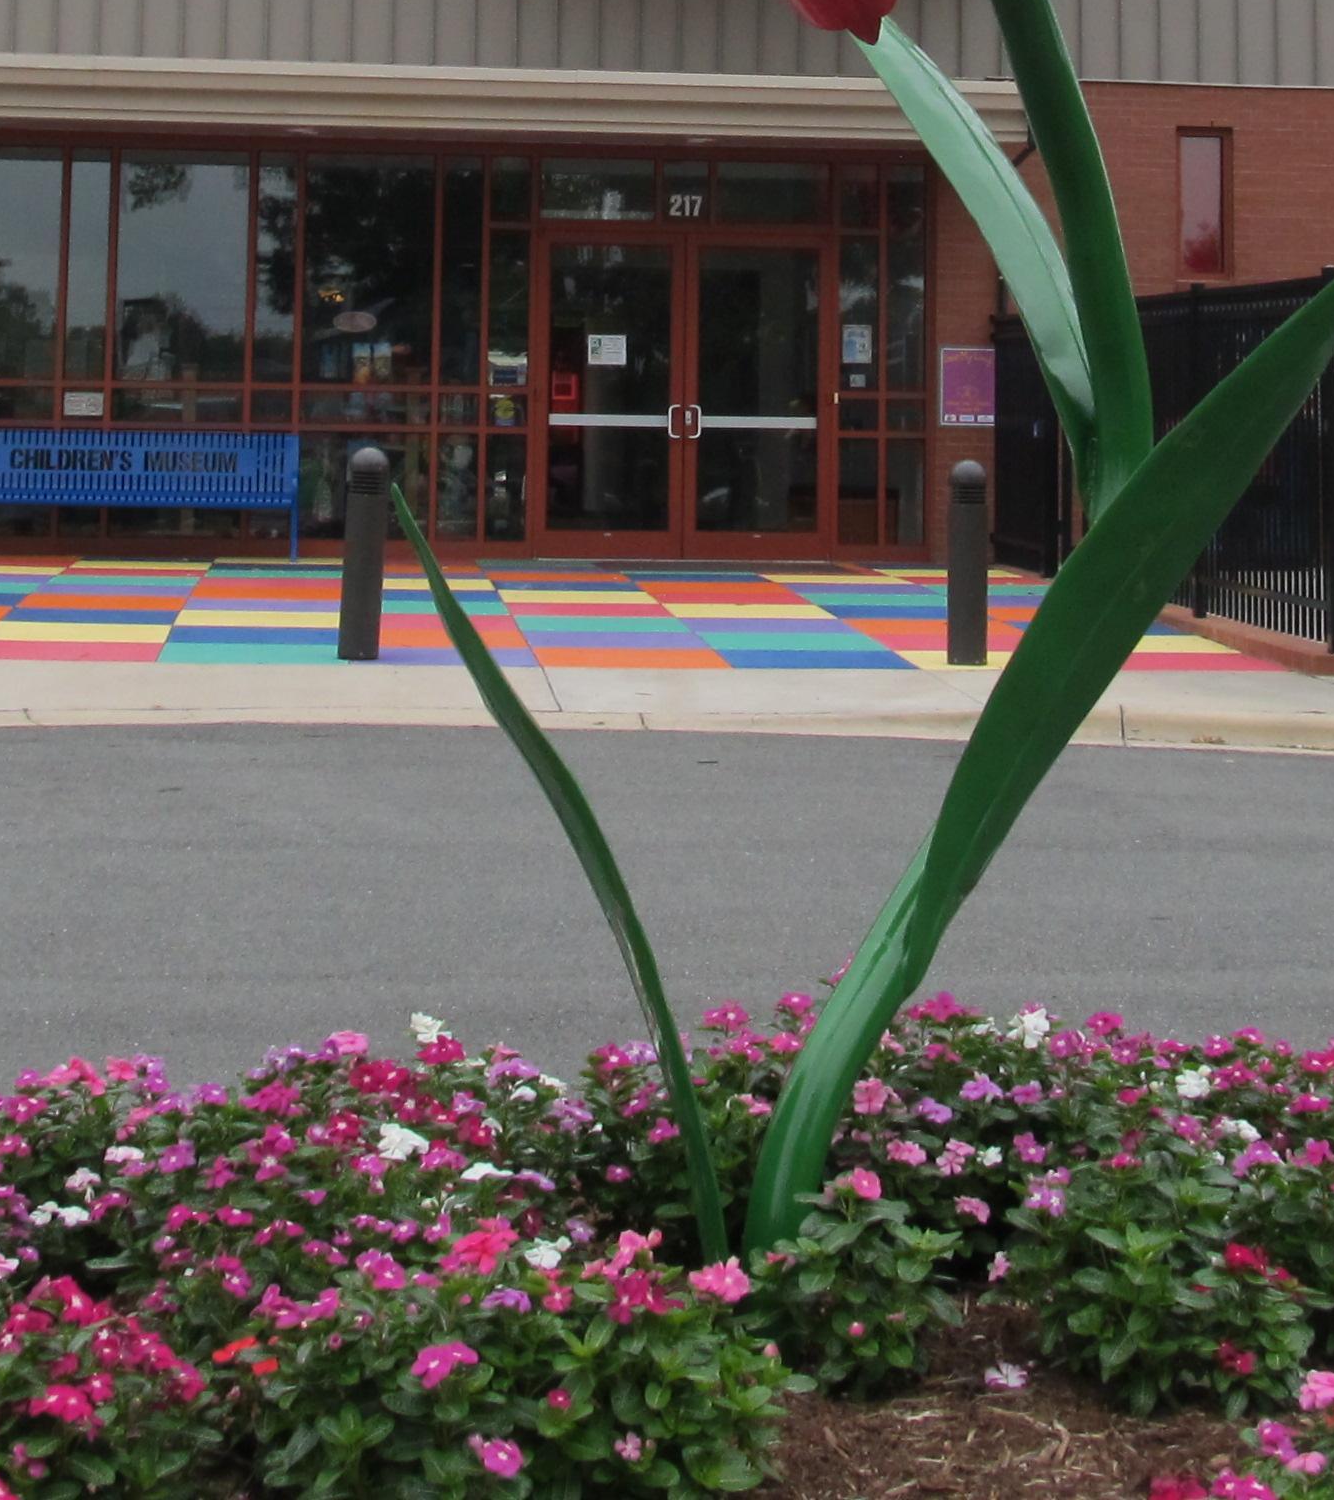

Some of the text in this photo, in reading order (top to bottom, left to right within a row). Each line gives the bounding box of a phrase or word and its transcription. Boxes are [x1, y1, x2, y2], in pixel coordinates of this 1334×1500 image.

[669, 194, 703, 217] 217
[10, 449, 238, 473] CHILDREN'S MUSEUM
